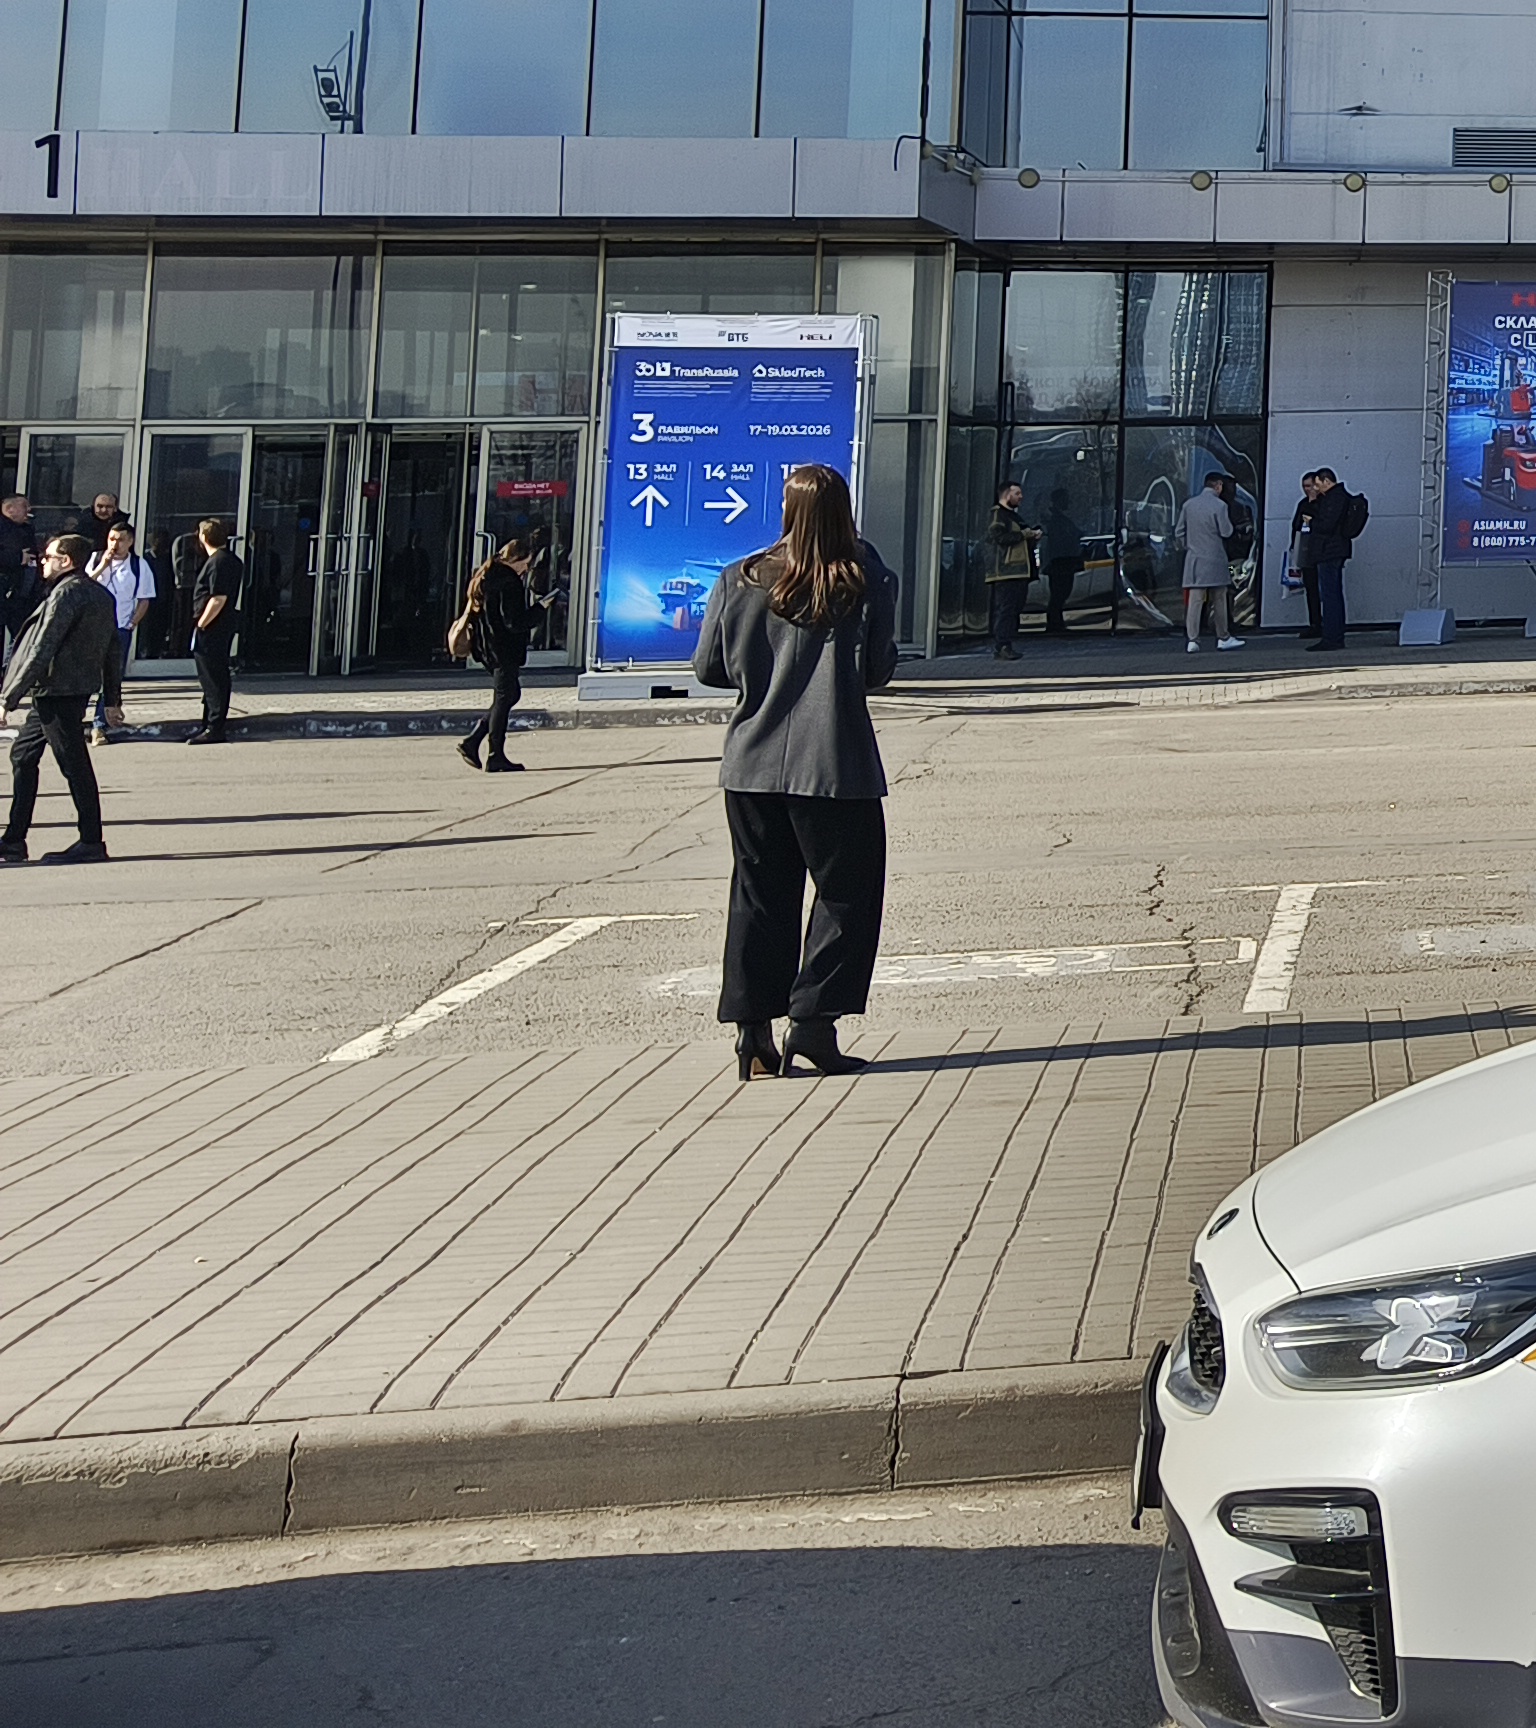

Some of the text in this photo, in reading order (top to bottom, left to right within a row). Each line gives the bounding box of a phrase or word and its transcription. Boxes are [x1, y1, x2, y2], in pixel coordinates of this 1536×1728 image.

[34, 133, 62, 199] 1
[1510, 333, 1522, 346] С
[629, 412, 655, 443] 3
[626, 463, 677, 480] 13 ЗАЛ
[703, 463, 754, 480] 14 ЗАЛ
